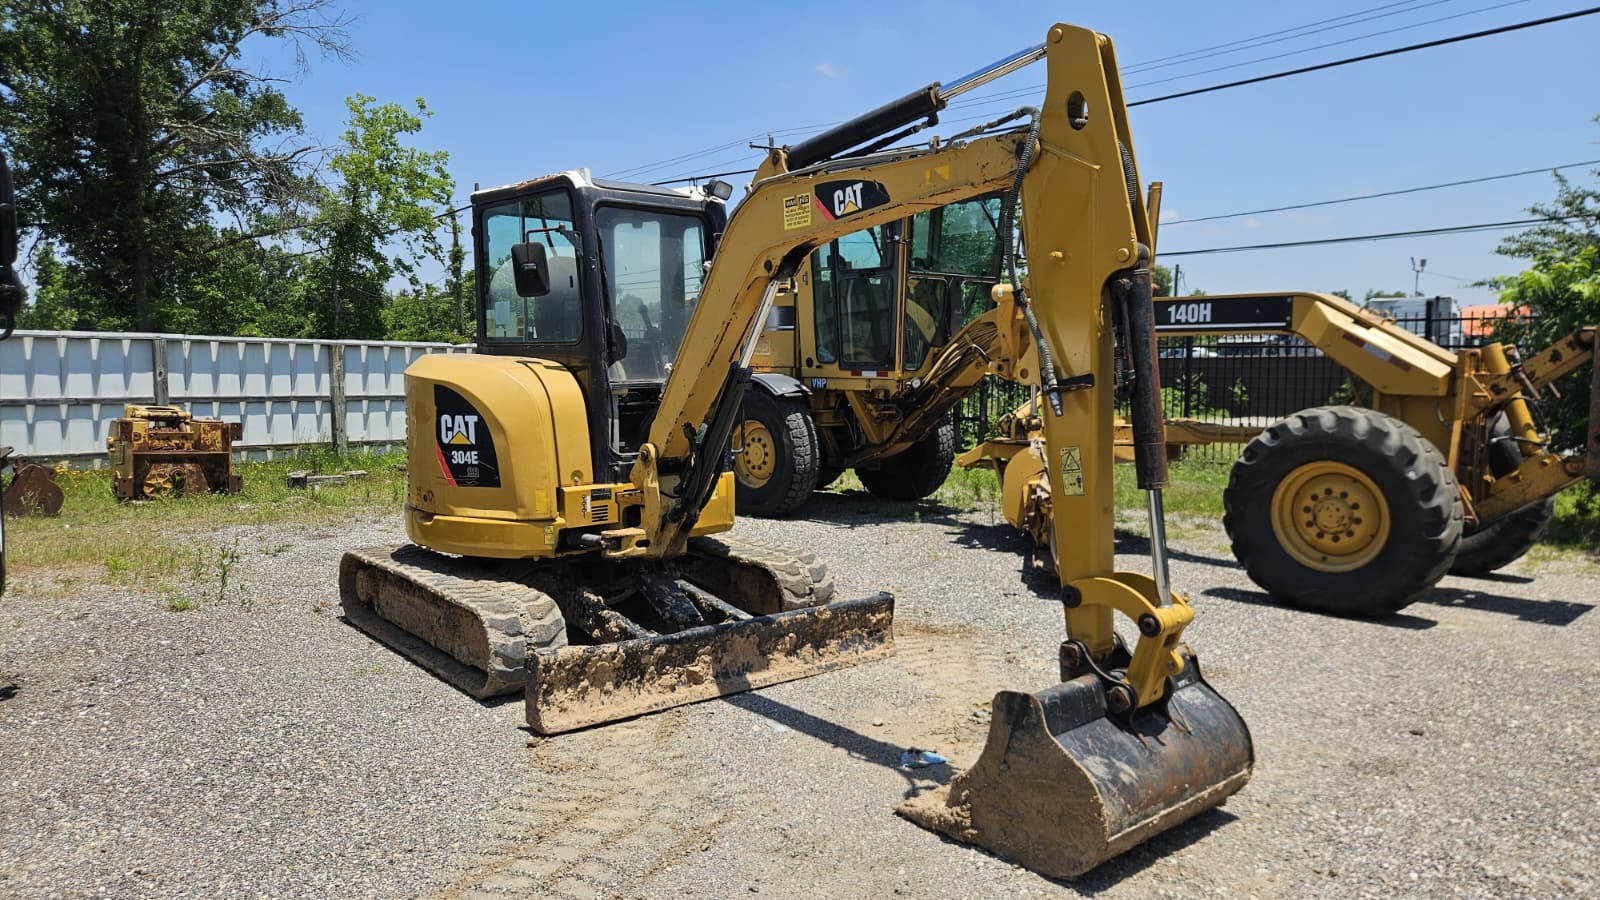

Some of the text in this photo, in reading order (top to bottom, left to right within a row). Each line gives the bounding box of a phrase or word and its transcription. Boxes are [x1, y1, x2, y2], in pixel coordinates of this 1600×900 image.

[834, 182, 863, 216] CAT
[1168, 303, 1212, 324] 140H
[812, 378, 827, 388] VHP
[441, 414, 478, 445] CAT
[452, 451, 479, 464] 304E
